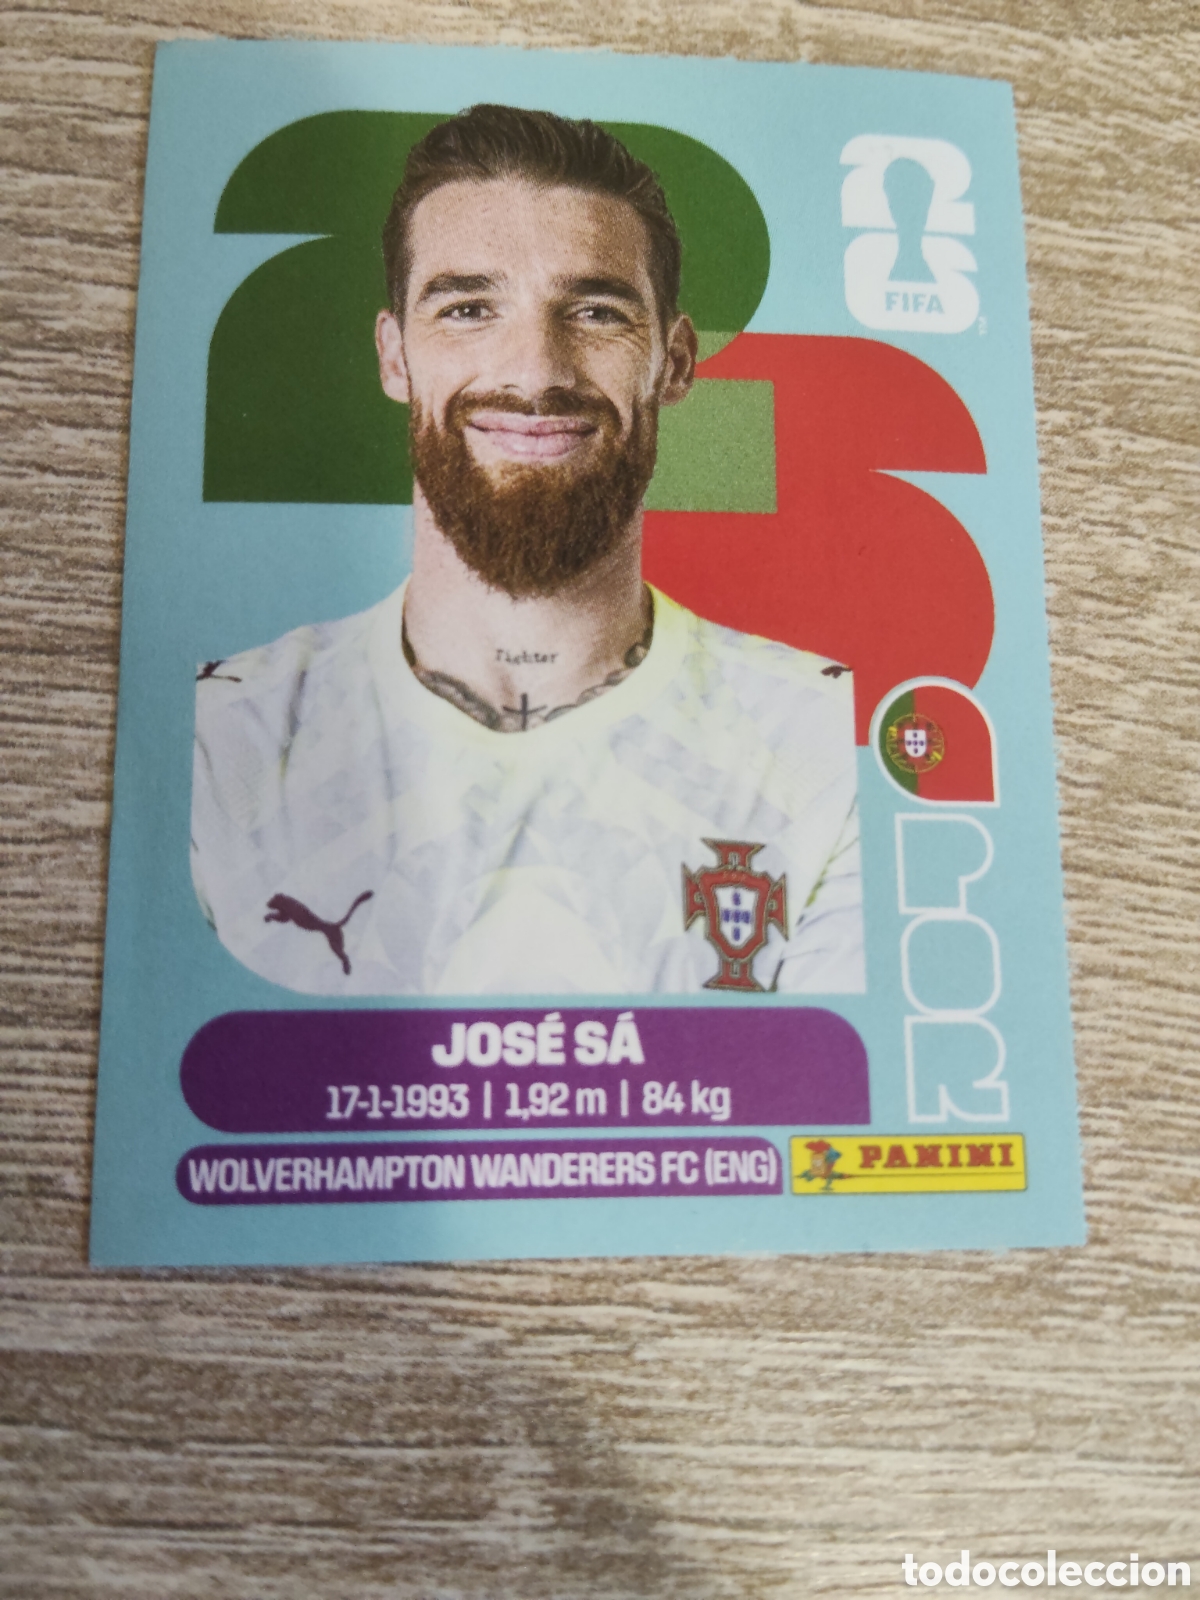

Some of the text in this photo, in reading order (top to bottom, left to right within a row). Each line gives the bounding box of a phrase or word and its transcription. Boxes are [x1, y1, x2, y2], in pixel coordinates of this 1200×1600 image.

[885, 291, 945, 314] FIFA
[895, 813, 1010, 1123] POR
[431, 1012, 645, 1067] JOSÉ SÁ
[326, 1083, 470, 1119] 17-1-1993
[505, 1082, 570, 1121] 1,92
[576, 1087, 607, 1115] m
[642, 1081, 685, 1115] 84
[691, 1080, 732, 1121] kg
[188, 1147, 777, 1193] WOLVERHAMPTON WANDERERS FC (ENG)
[858, 1143, 1015, 1168] PANINI
